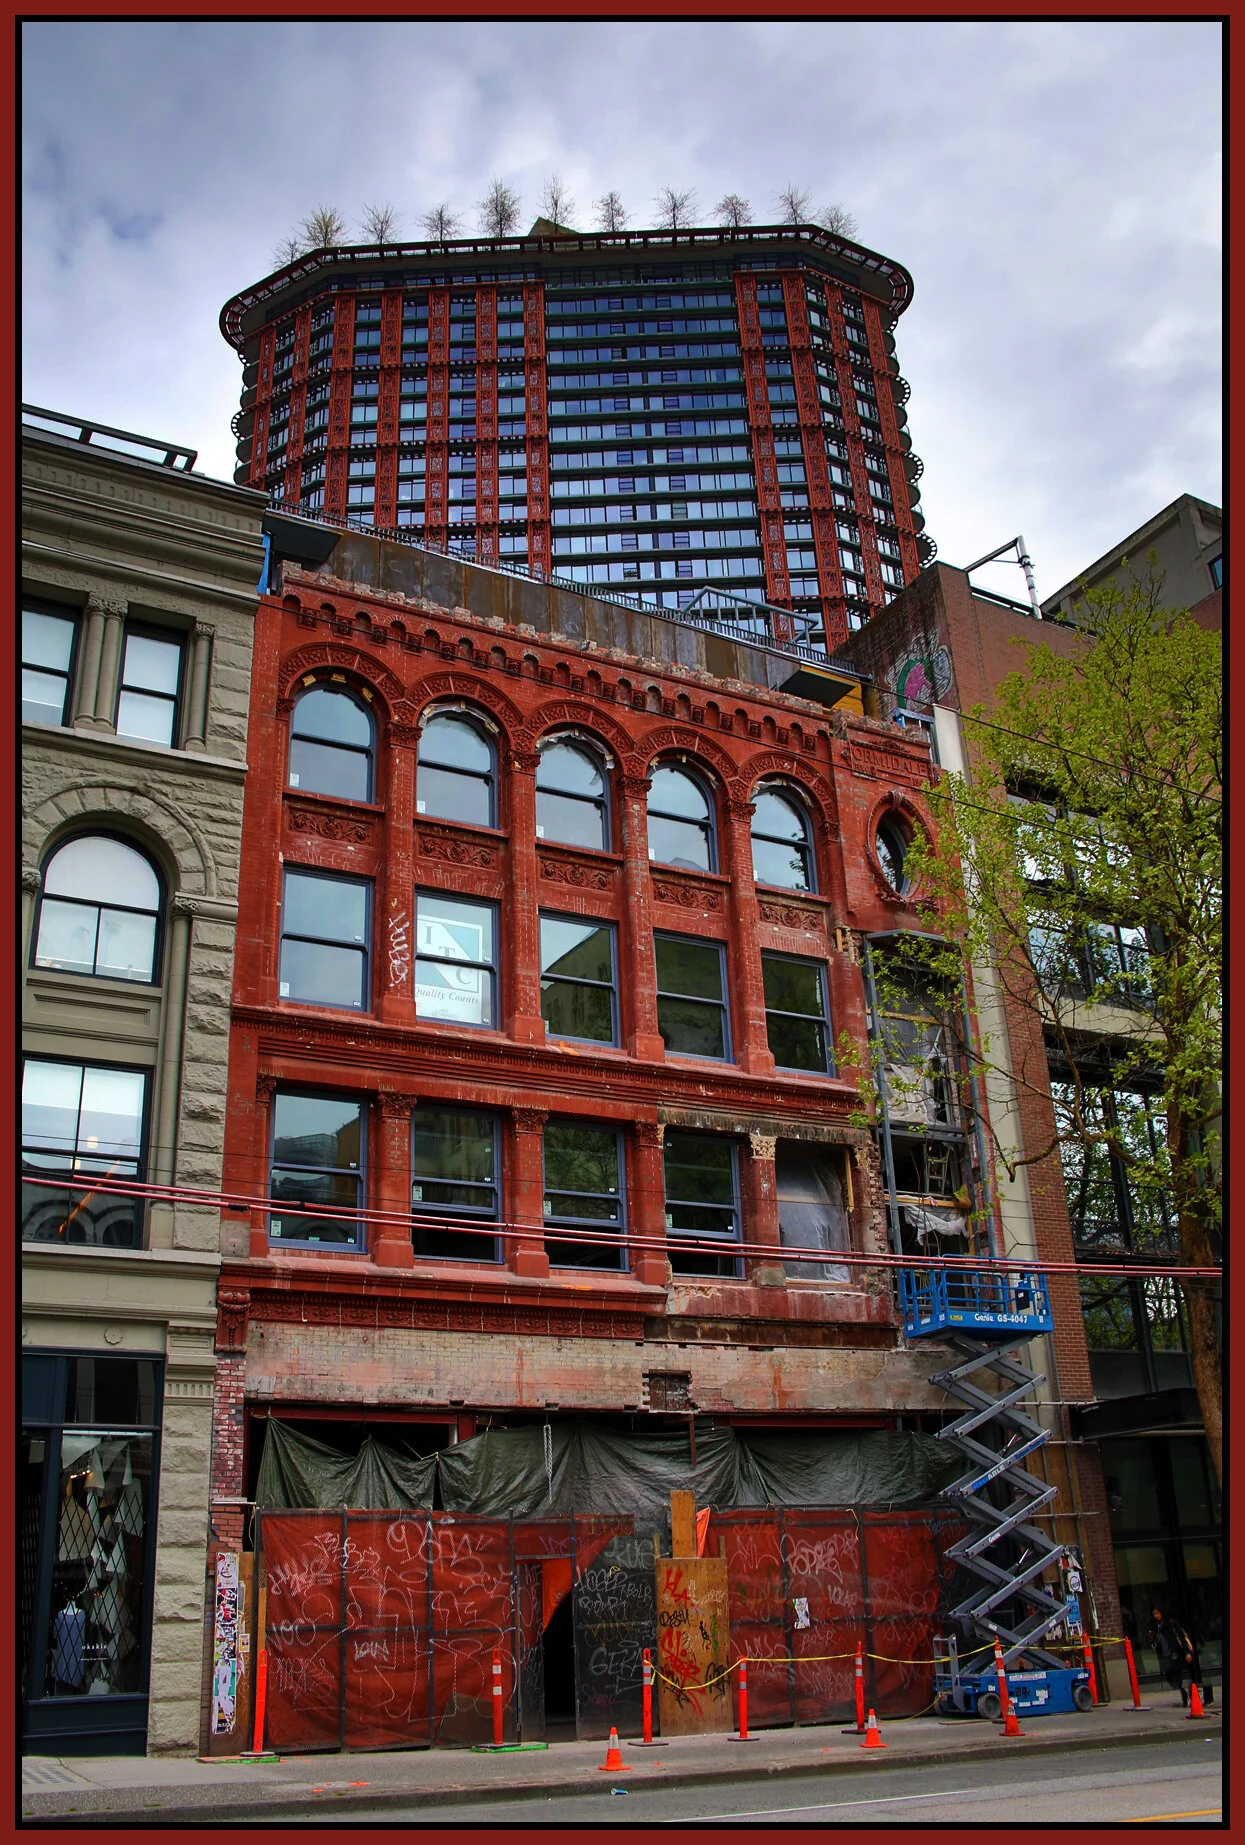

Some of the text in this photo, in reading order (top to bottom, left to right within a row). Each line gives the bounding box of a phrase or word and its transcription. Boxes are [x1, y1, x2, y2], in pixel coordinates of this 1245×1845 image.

[852, 748, 927, 777] ORMIDALE
[448, 992, 480, 1005] Counts
[974, 1313, 1028, 1324] Genie GS-4047
